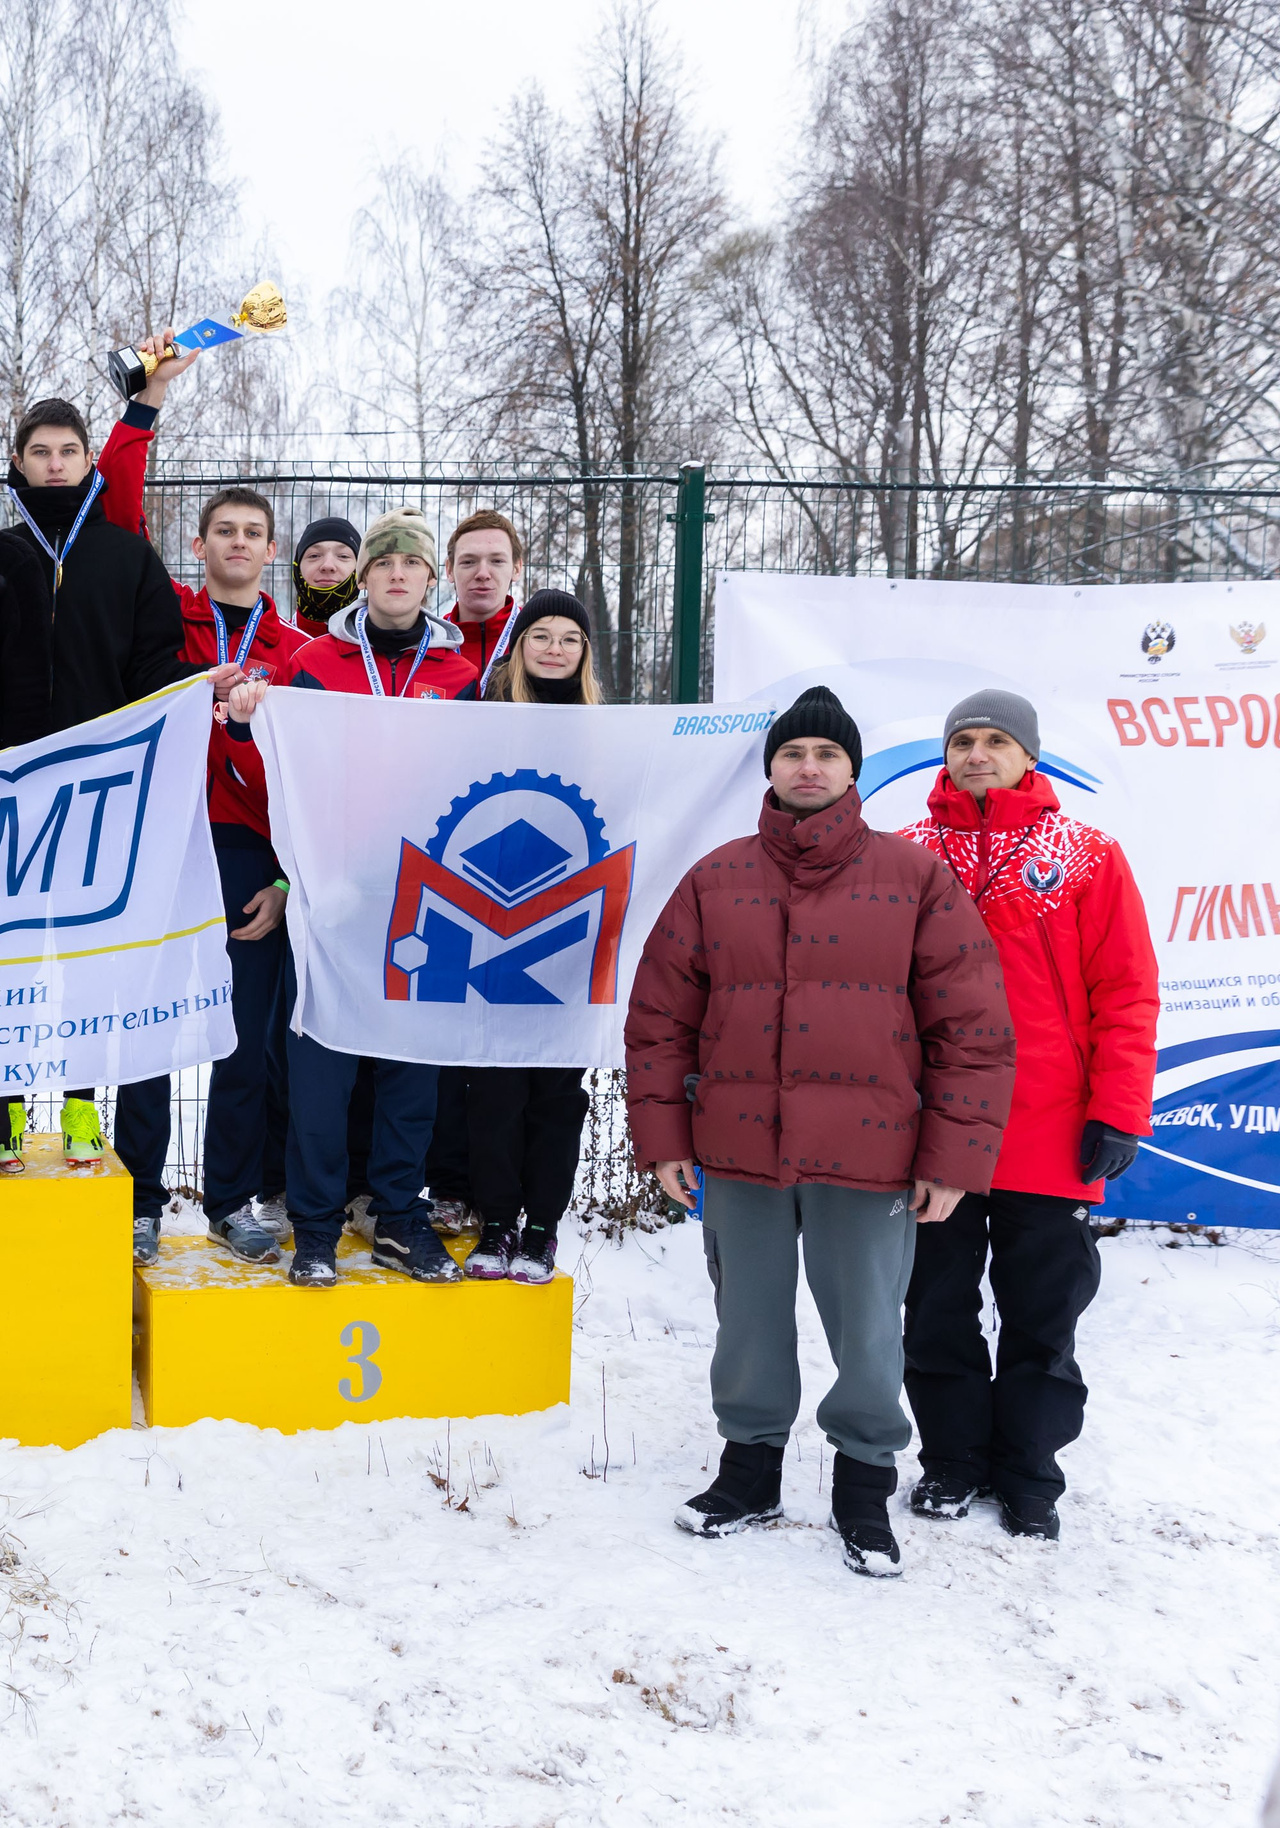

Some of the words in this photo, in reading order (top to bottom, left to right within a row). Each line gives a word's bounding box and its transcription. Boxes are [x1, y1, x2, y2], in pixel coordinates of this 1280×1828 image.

[672, 710, 777, 735] BARSSPORT
[822, 981, 906, 994] FABLE
[1158, 976, 1242, 993] чающихся
[1246, 997, 1256, 1007] и
[792, 1069, 878, 1083] FABLE
[337, 1320, 383, 1402] 3
